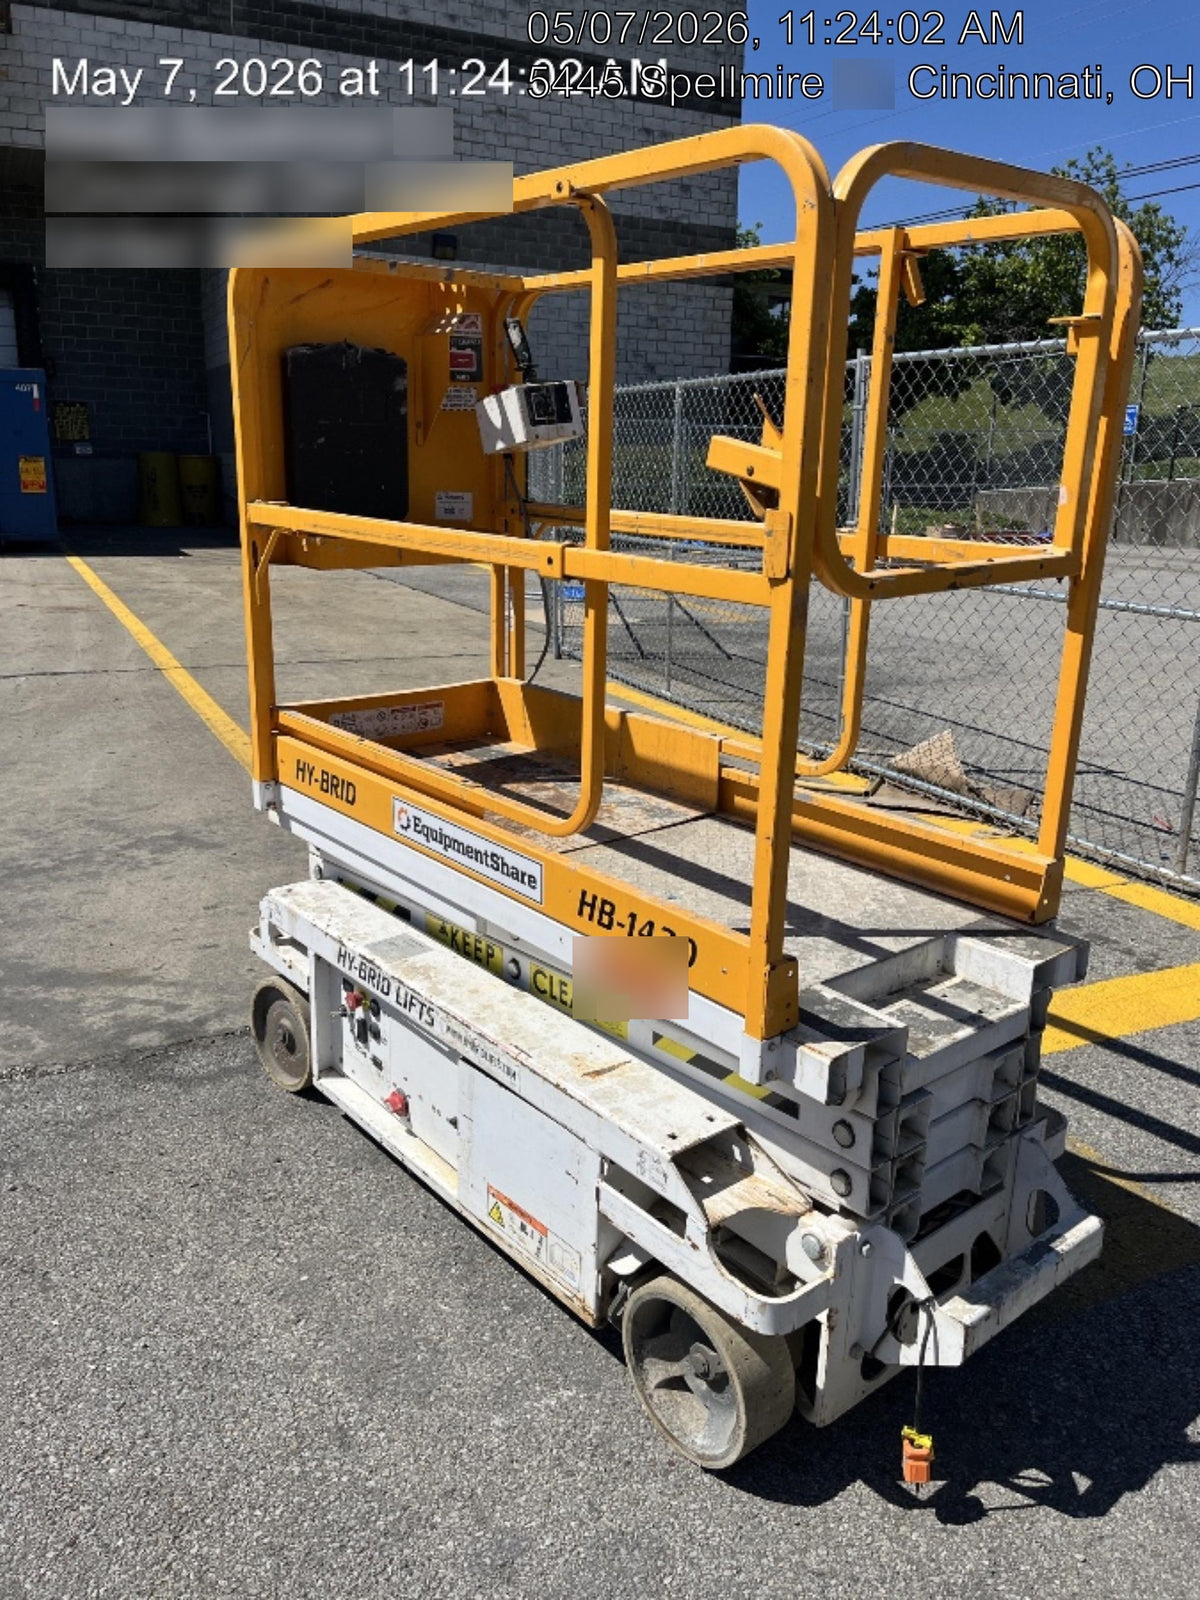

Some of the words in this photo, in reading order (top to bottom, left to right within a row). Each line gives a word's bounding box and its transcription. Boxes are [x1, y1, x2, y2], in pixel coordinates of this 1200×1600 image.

[295, 758, 357, 807] HY-BRID
[412, 814, 538, 891] EquipmentShare
[450, 926, 495, 967] KEEP
[337, 946, 391, 997] HY-BRID
[395, 986, 436, 1028] LIFTS
[532, 968, 574, 1010] CLE
